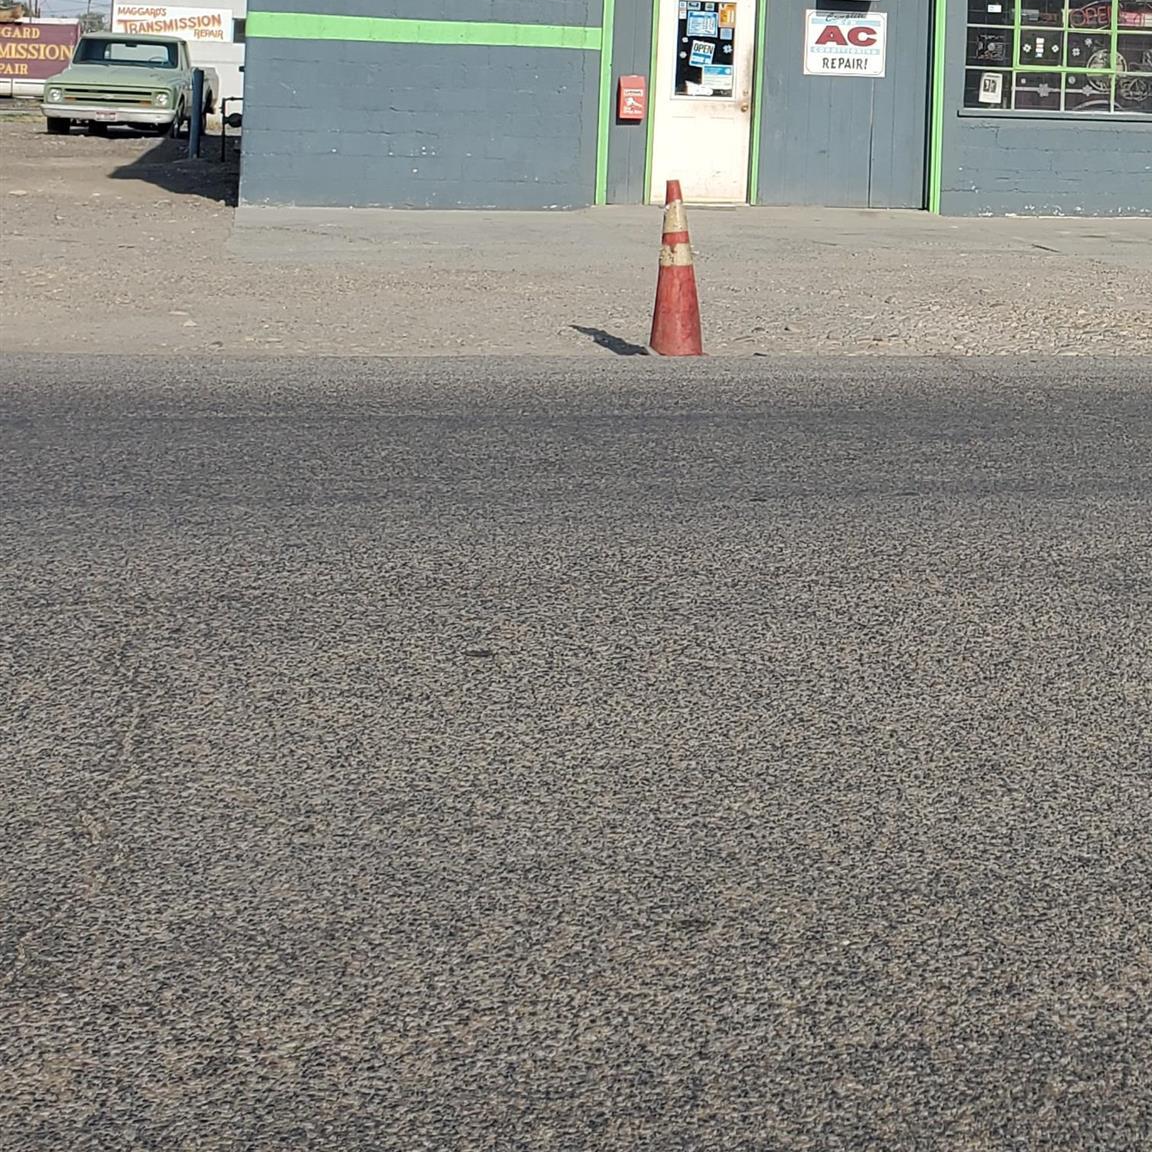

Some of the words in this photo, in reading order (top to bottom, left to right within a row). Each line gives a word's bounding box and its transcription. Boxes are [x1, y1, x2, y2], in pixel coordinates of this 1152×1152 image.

[117, 14, 222, 34] TRANSMISSION
[193, 29, 224, 40] REPAIR
[815, 25, 877, 47] AC
[822, 57, 868, 70] REPAIR!
